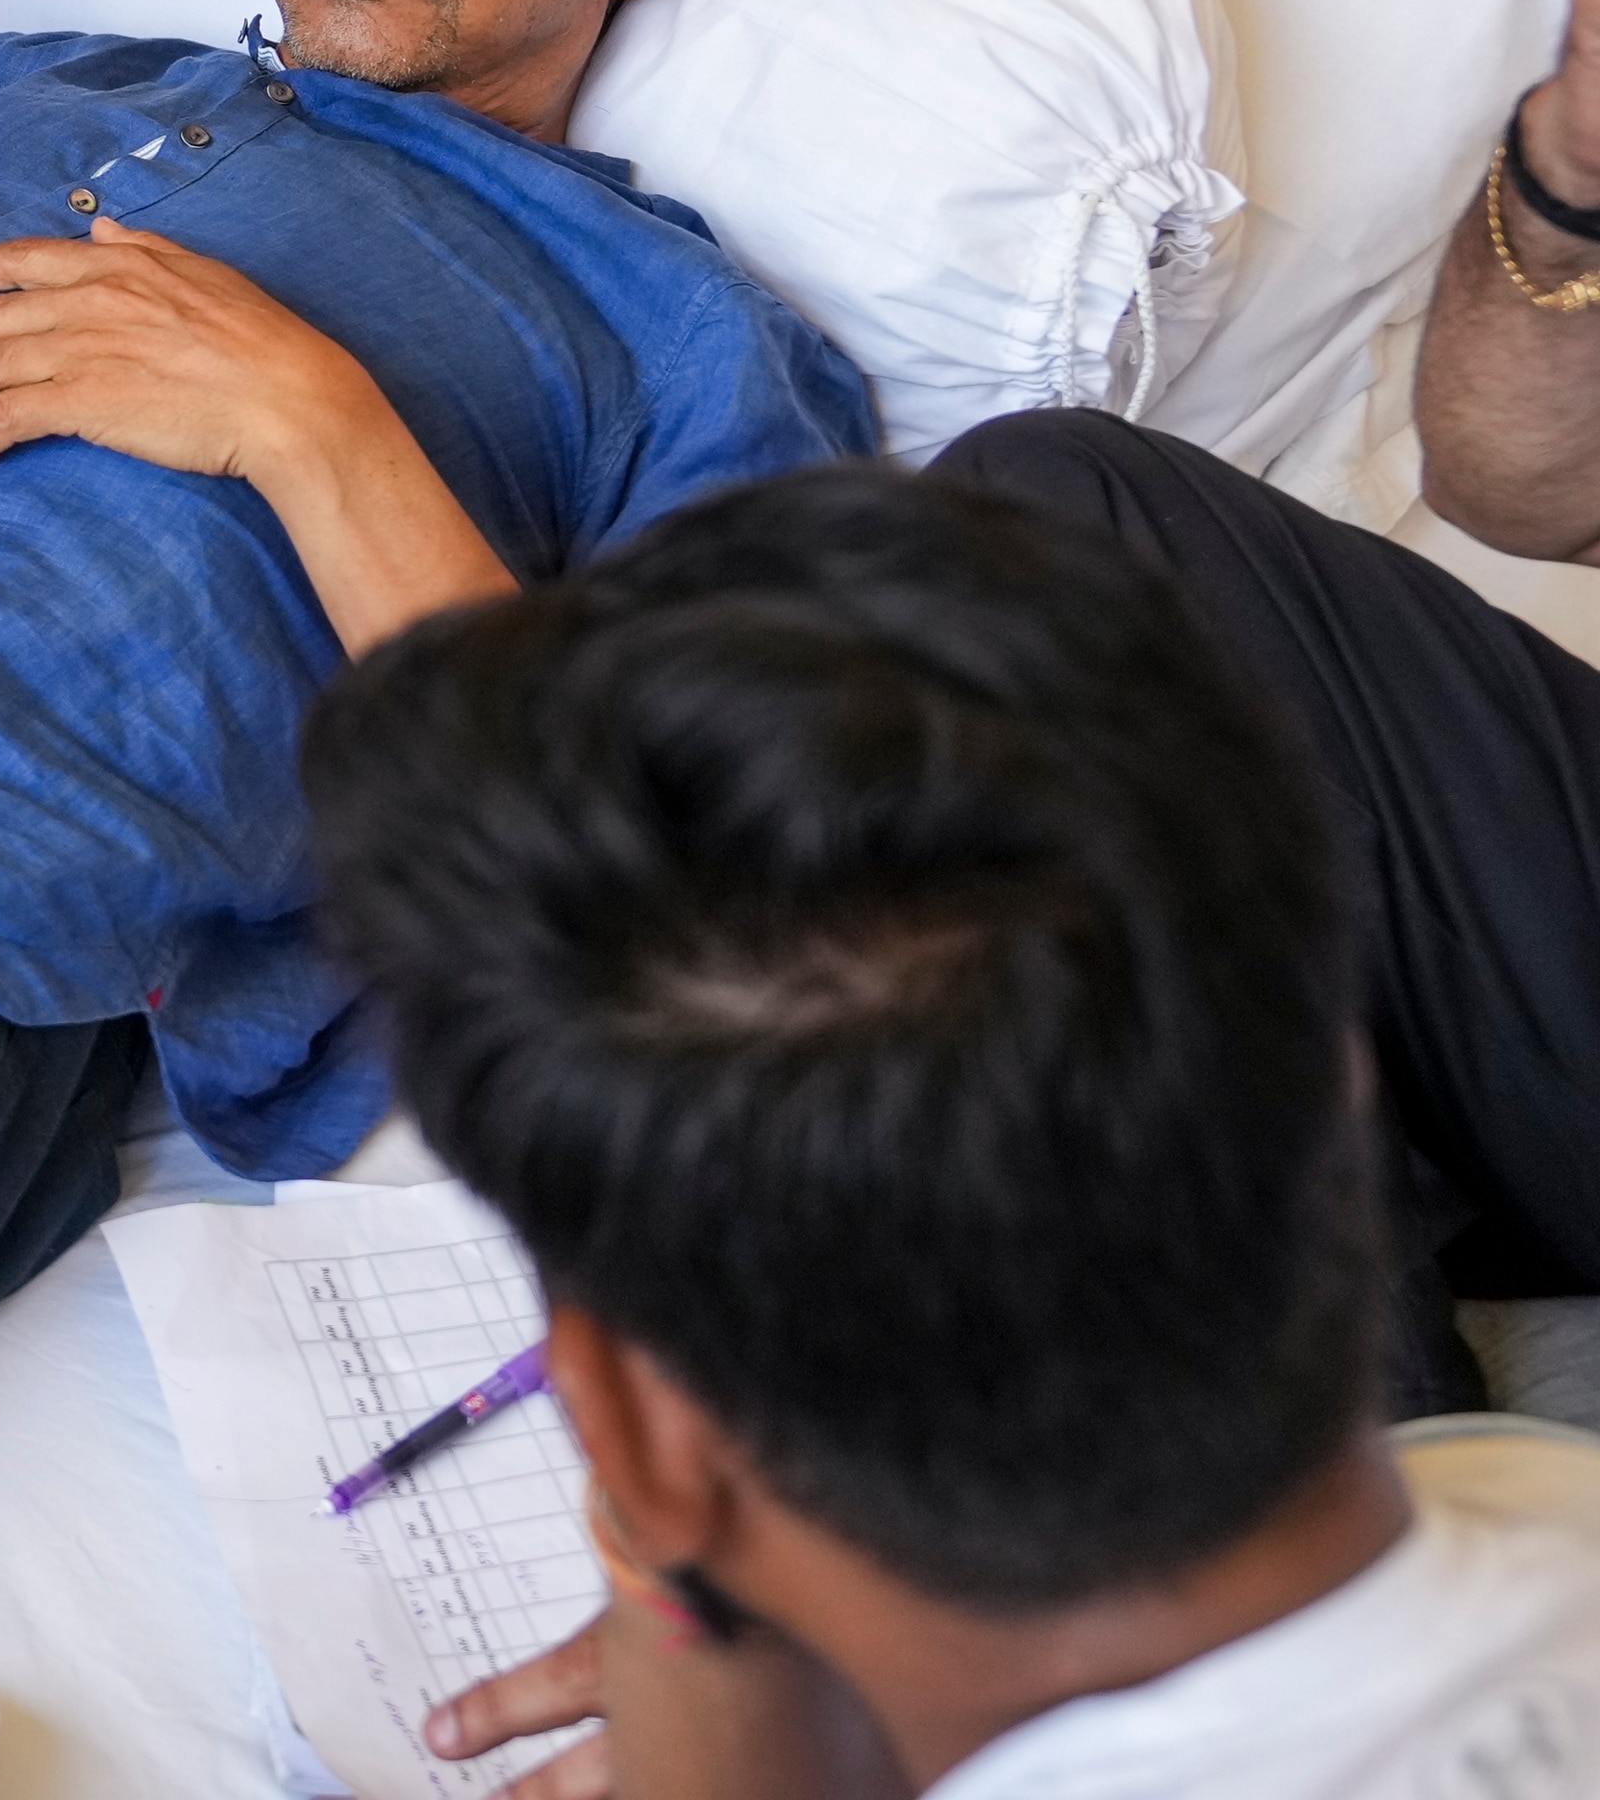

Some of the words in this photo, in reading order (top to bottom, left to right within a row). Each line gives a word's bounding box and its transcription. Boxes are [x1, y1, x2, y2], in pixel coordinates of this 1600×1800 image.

[321, 1266, 339, 1299] Reading
[310, 1286, 322, 1300] PM
[337, 1306, 354, 1338] Reading
[325, 1324, 338, 1339] AM
[352, 1340, 371, 1373] Reading
[341, 1359, 353, 1374] PM
[367, 1376, 384, 1412] Reading
[355, 1397, 368, 1413] AM
[387, 1478, 400, 1494] AM
[417, 1499, 436, 1535] Reading
[405, 1521, 418, 1537] PM
[433, 1537, 453, 1571] Reading
[422, 1558, 436, 1574] AM
[451, 1576, 471, 1612] Reading
[440, 1599, 455, 1617] PM
[470, 1613, 489, 1650] Reading
[456, 1636, 472, 1654] AM
